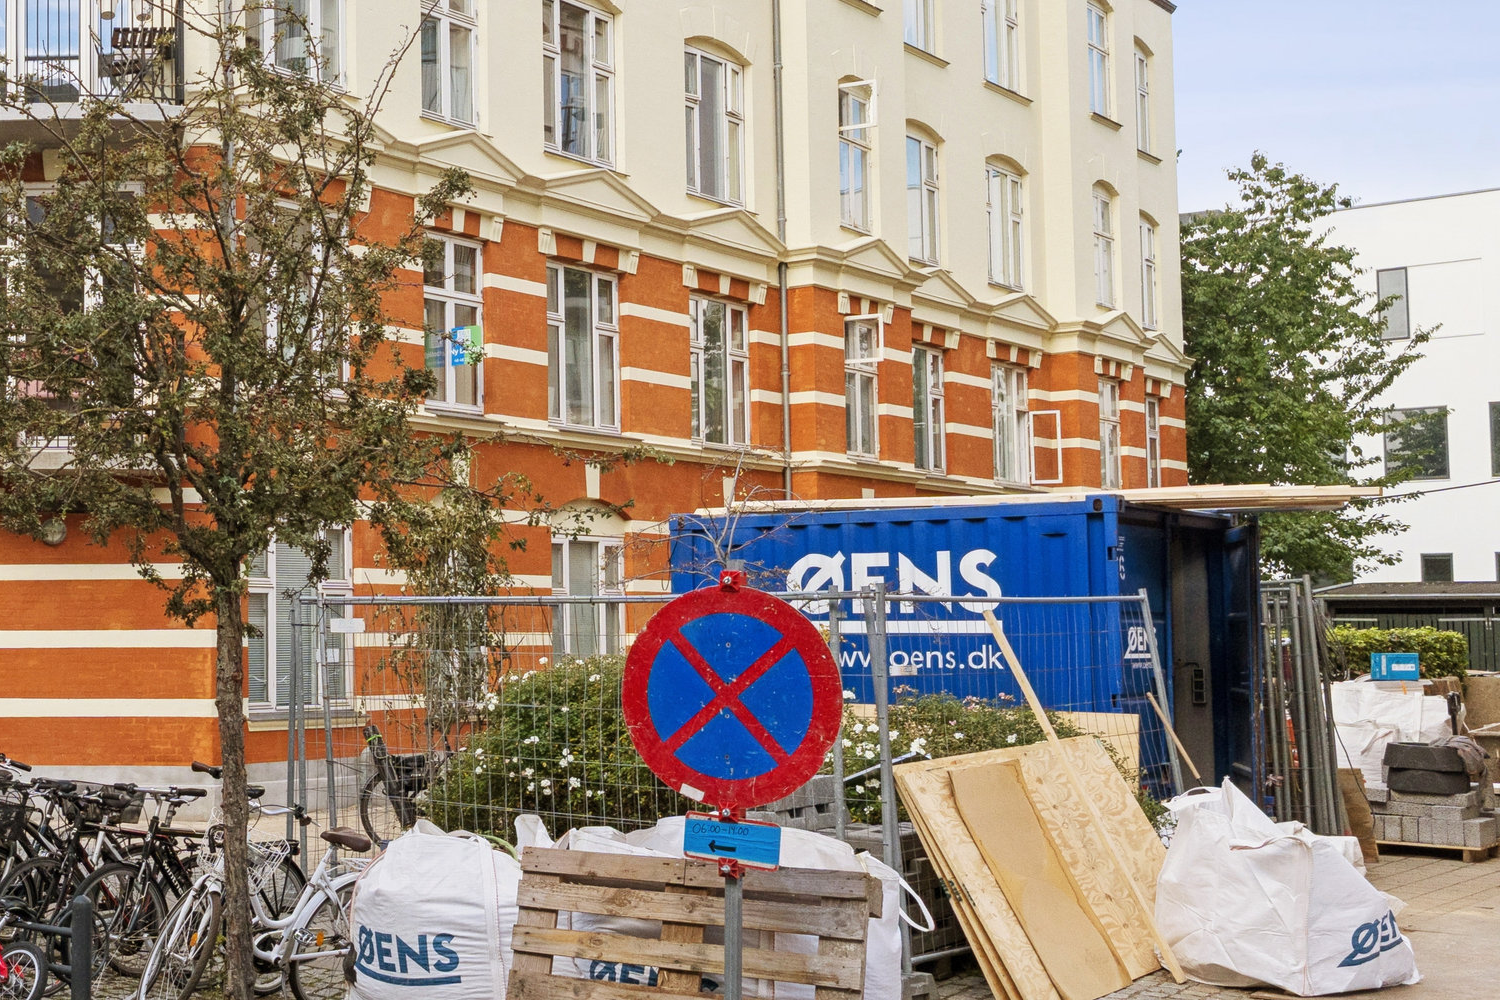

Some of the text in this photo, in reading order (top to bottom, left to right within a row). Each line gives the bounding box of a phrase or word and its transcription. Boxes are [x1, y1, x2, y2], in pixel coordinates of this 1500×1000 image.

[786, 549, 1002, 615] ØENS
[1127, 626, 1158, 652] ØEN
[357, 924, 460, 975] ØENS
